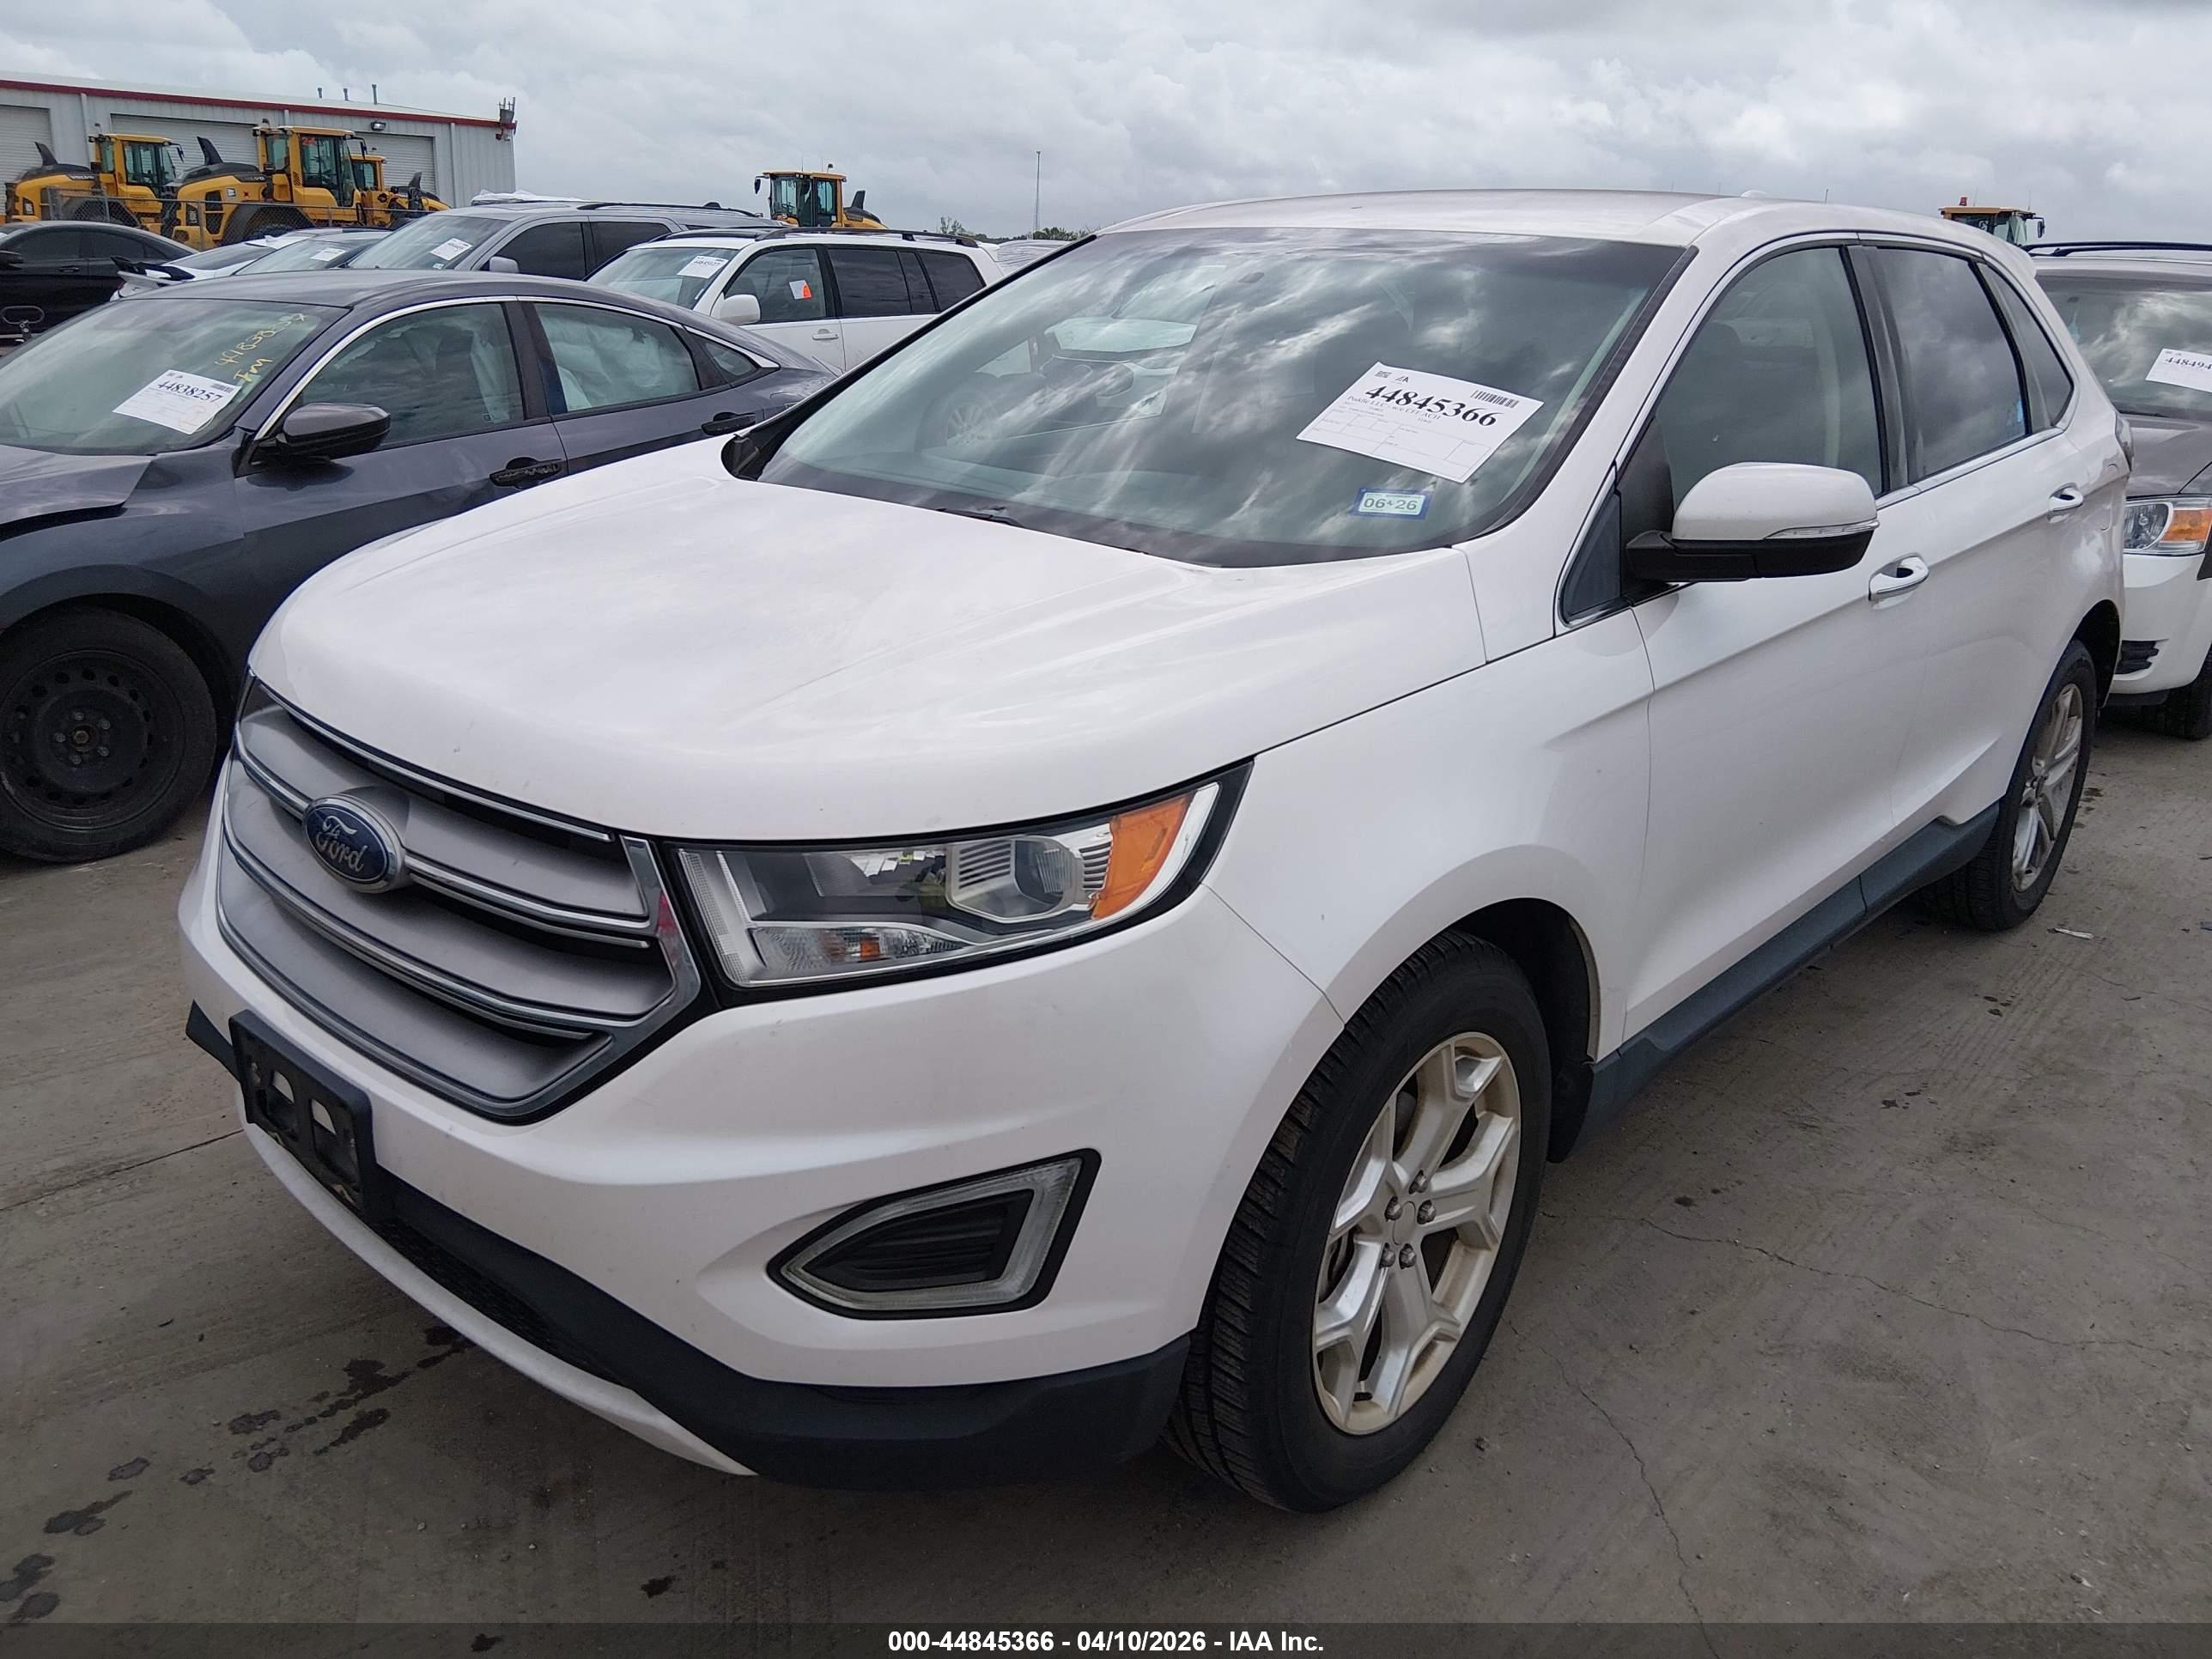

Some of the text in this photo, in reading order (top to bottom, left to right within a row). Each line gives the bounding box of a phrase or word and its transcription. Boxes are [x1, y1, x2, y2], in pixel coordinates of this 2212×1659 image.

[158, 380, 223, 403] 44838257
[1365, 386, 1504, 426] 44845366
[315, 815, 368, 872] Ford
